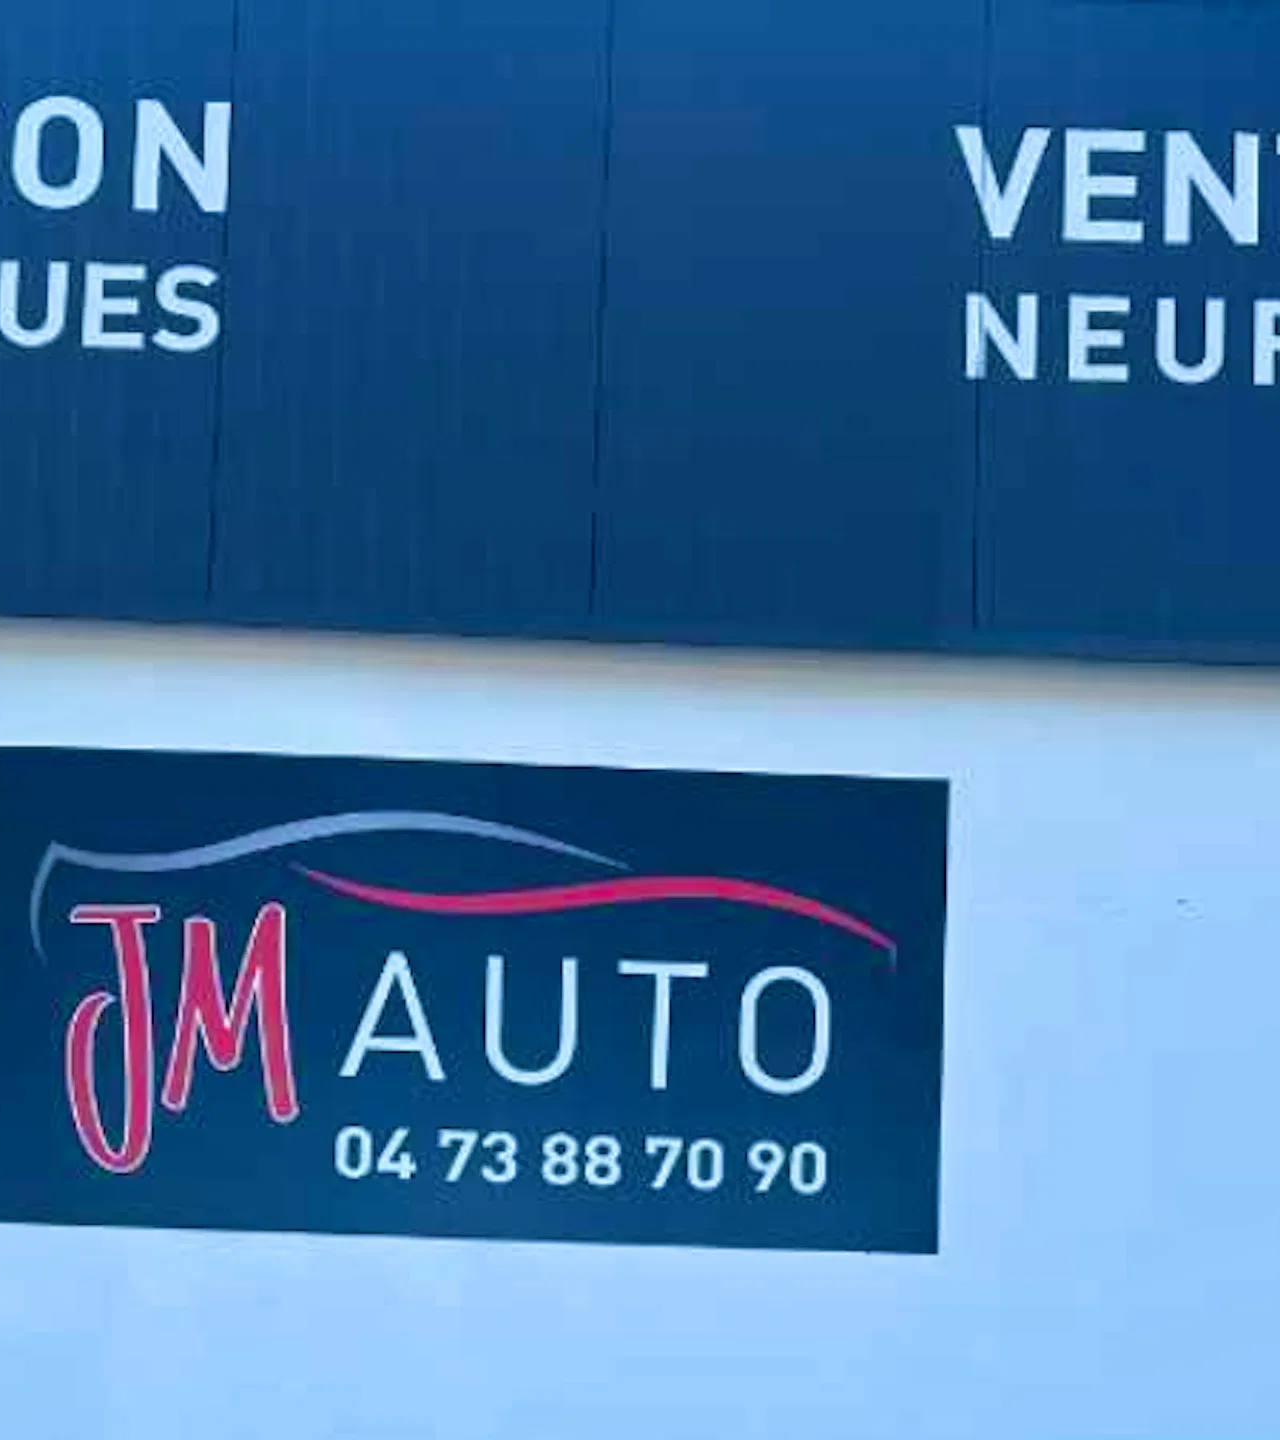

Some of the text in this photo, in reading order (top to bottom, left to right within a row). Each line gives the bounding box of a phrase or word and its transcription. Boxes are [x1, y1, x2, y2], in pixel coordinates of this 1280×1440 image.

[65, 900, 830, 1173] JM AUTO
[335, 1126, 826, 1194] 04 73 88 70 90
